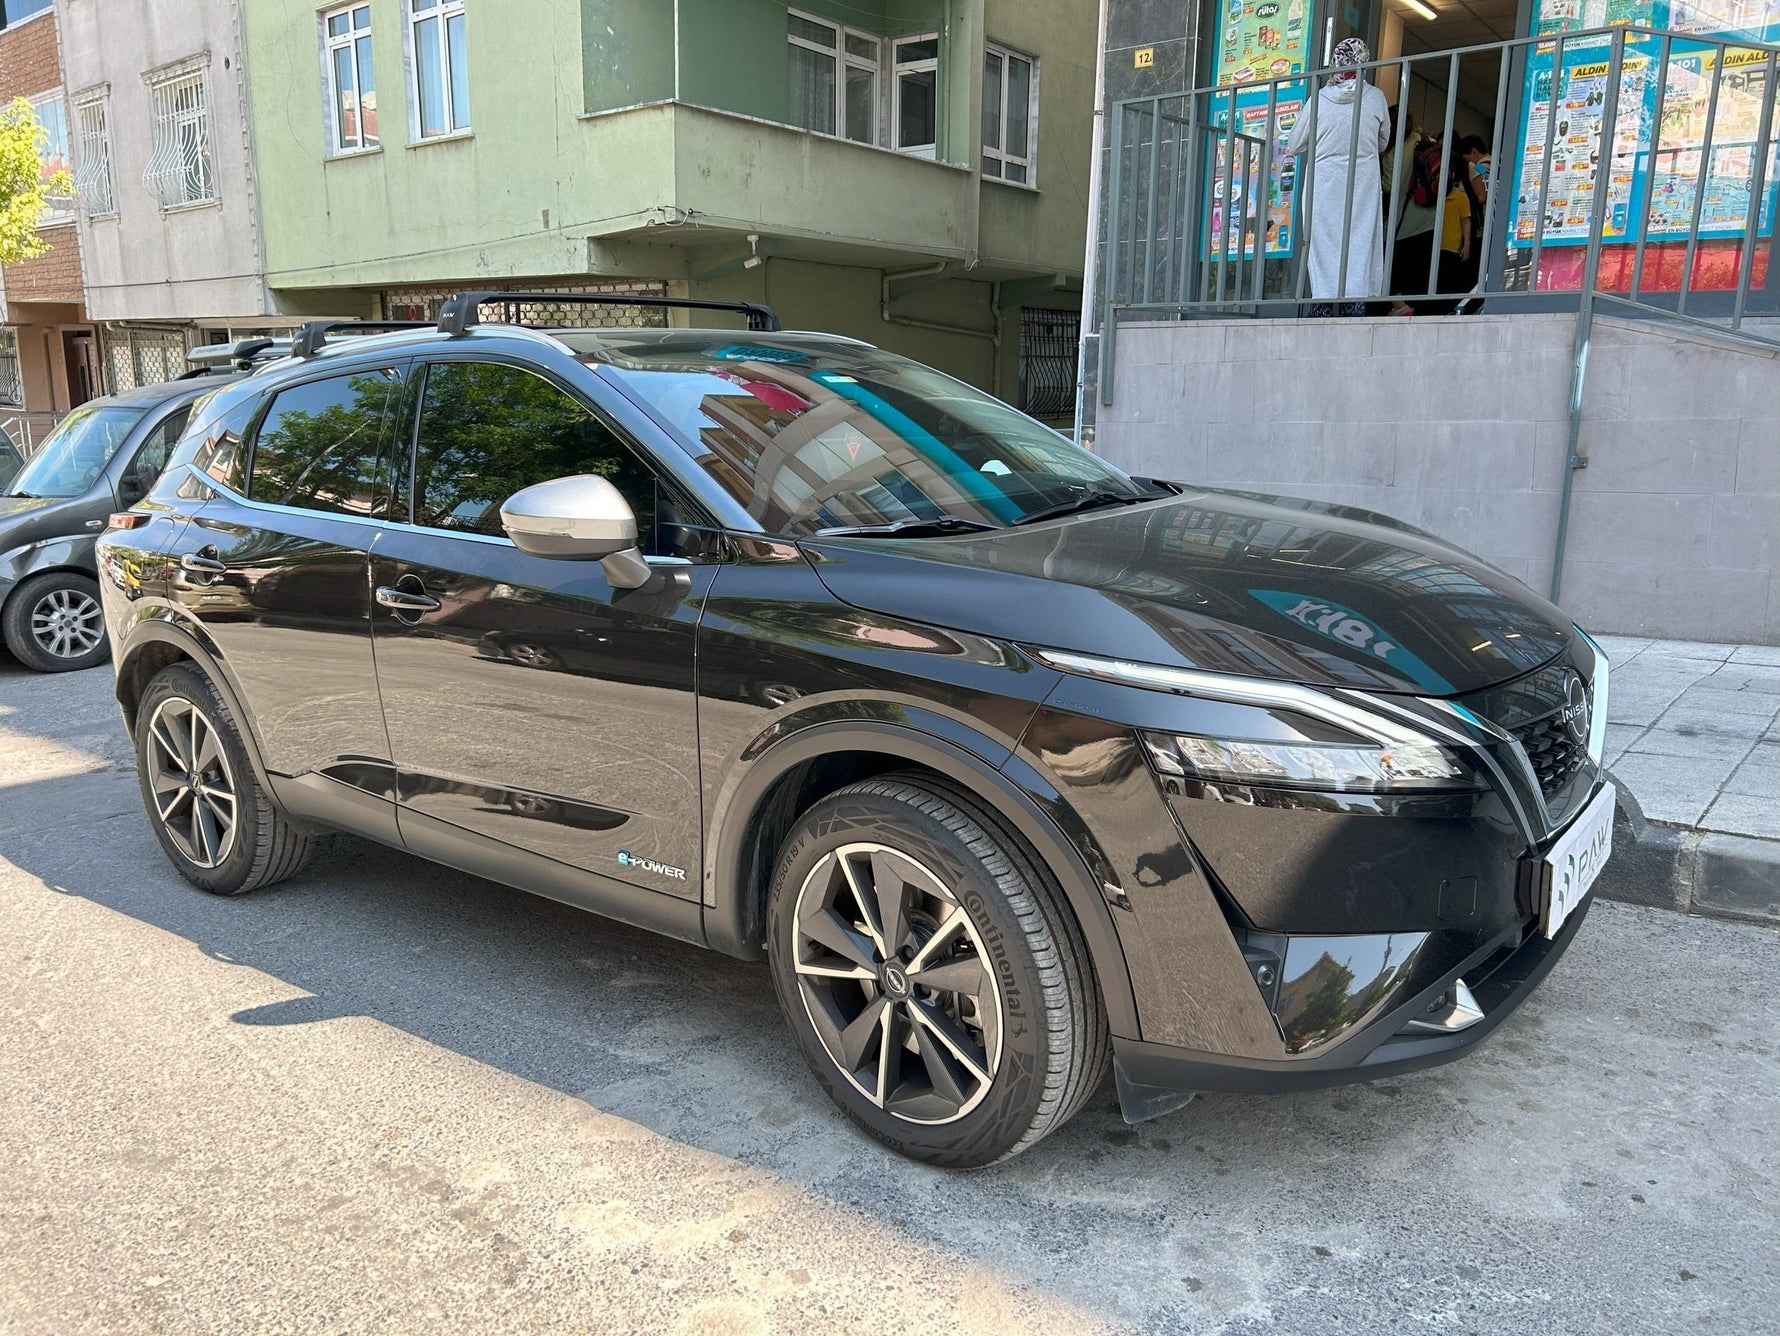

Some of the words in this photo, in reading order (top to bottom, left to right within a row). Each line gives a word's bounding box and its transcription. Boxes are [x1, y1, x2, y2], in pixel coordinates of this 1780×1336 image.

[1709, 54, 1744, 67] ADIN
[1575, 64, 1607, 77] ALDIN
[963, 890, 1027, 1020] Continental
